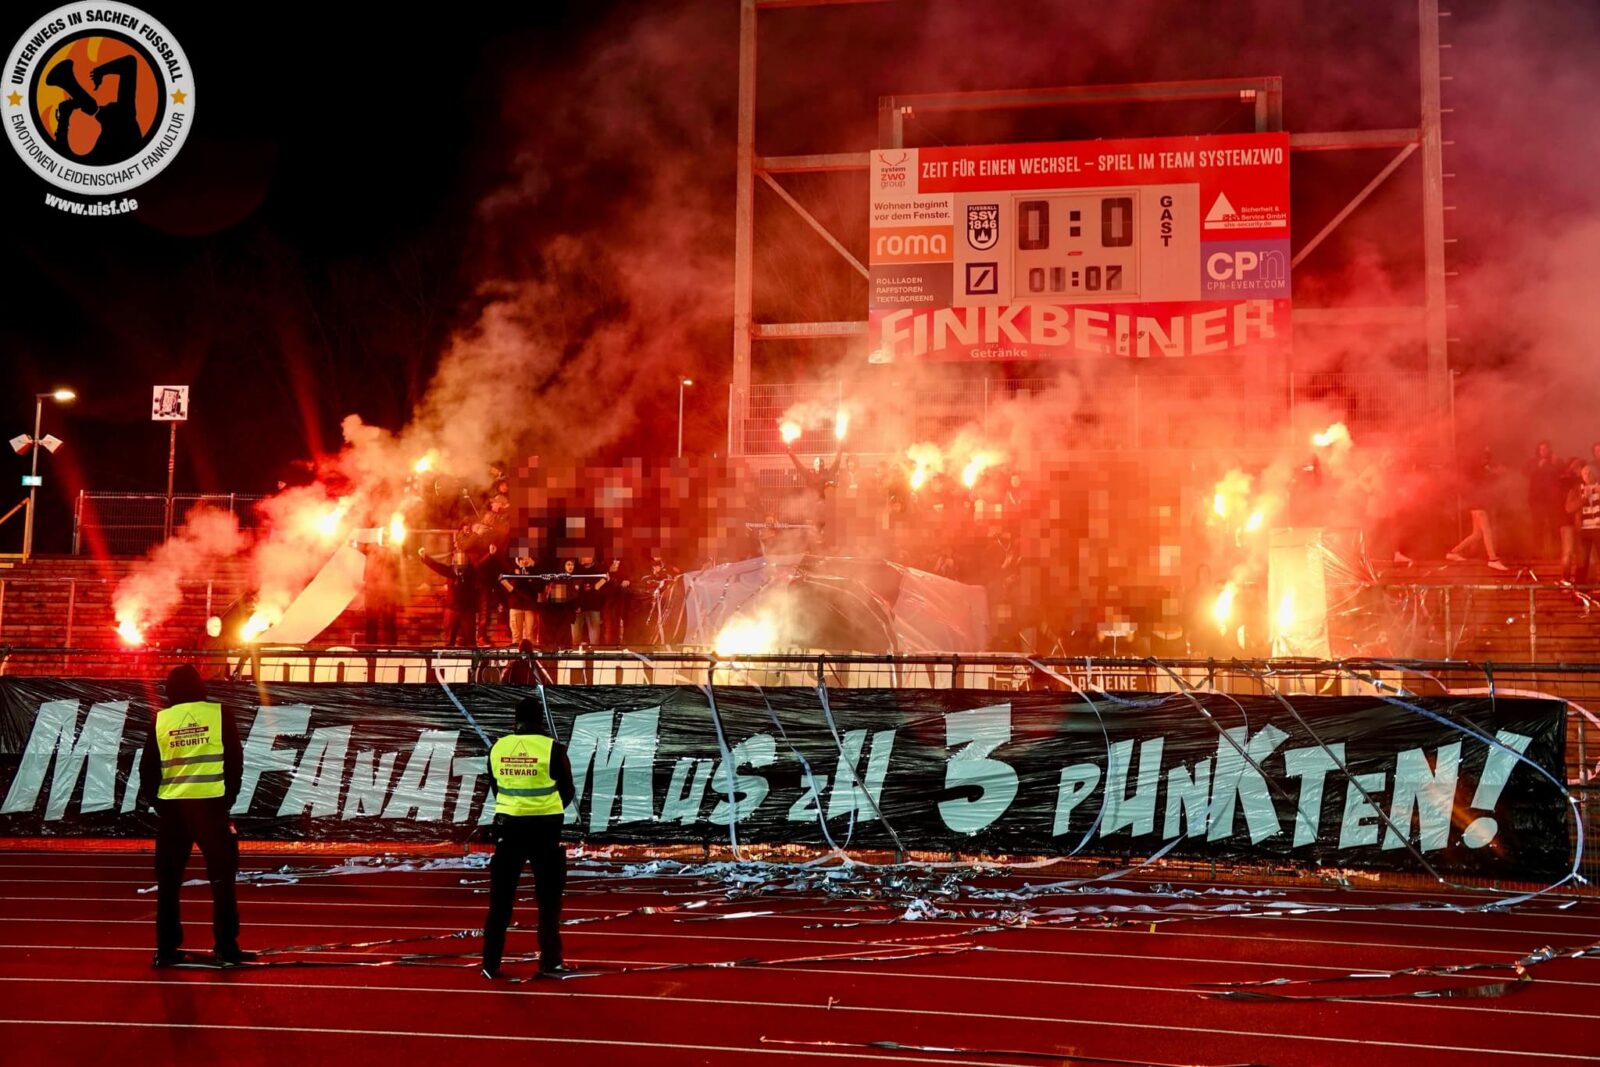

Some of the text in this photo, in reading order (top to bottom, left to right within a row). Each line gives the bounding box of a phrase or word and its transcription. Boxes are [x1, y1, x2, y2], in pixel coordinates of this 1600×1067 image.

[922, 162, 949, 179] ZEIT
[952, 158, 976, 178] FÜR
[979, 158, 1016, 177] EINEN
[1019, 156, 1081, 175] WECHSEL
[1098, 153, 1135, 172] SPIEL
[1138, 152, 1155, 170] IM
[1158, 151, 1195, 169] TEAM
[1199, 147, 1284, 168] SYSTEMZWO
[874, 200, 948, 211] Wohnen beginnt
[891, 212, 912, 221] dem
[913, 211, 951, 220] Fenster.
[969, 211, 998, 221] SSV
[1159, 195, 1174, 248] GAST
[969, 219, 998, 230] 1846
[876, 234, 947, 256] roma
[1206, 280, 1286, 290] CPN-EVENT.COM
[876, 295, 934, 303] TEXTILSCREENS
[879, 299, 1277, 360] FINKBEINER
[970, 346, 1028, 358] Getränke
[170, 737, 210, 748] SECURITY
[1, 699, 150, 821] MI
[937, 702, 1019, 836] 3
[1053, 723, 1533, 852] PUNKTEN!
[499, 768, 538, 776] STEWARD
